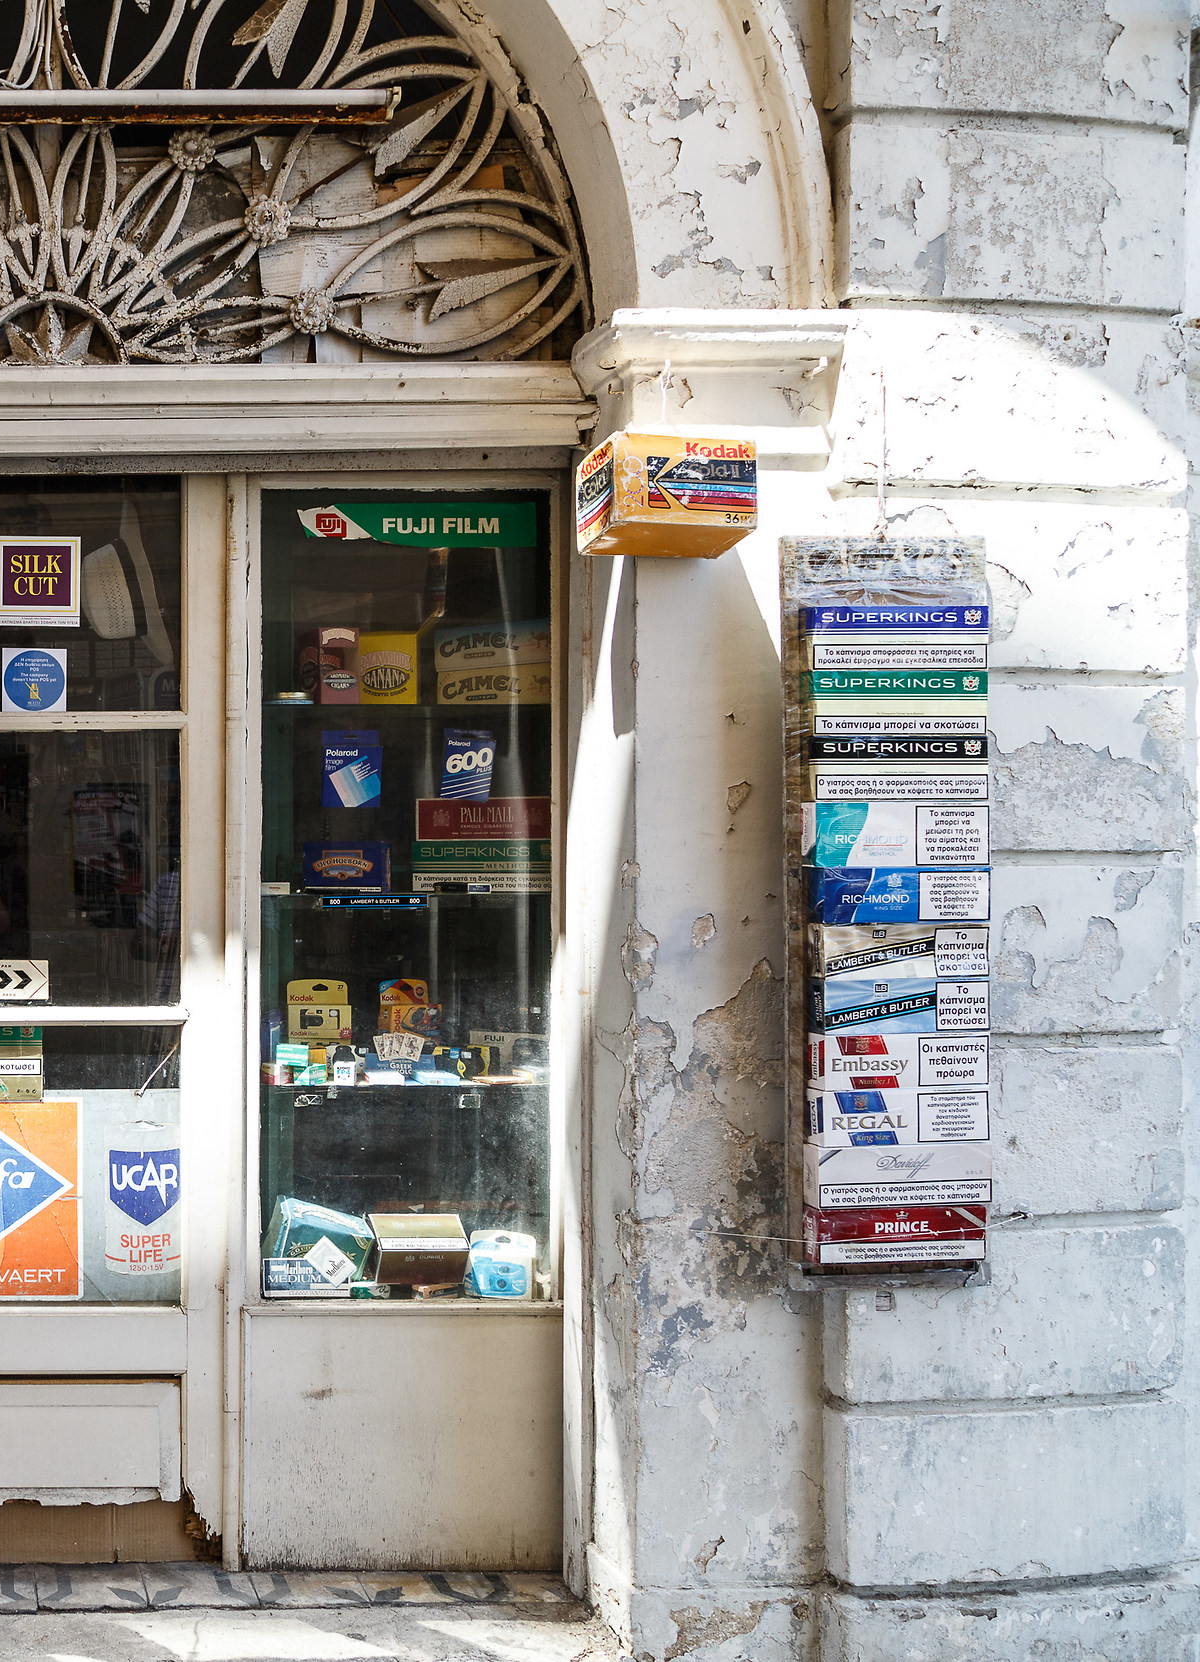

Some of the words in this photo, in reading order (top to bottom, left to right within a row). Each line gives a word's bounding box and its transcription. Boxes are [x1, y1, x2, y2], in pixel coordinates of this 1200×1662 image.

[686, 442, 750, 458] Kodak
[580, 448, 610, 479] Kodak
[725, 514, 740, 524] 36
[382, 518, 435, 534] FUJI
[442, 518, 500, 534] FILM
[10, 554, 63, 574] SILK
[13, 576, 58, 596] CUT
[821, 612, 958, 623] SUPERKINGS
[440, 632, 519, 658] CAMEL
[919, 650, 929, 658] τις
[364, 668, 406, 689] BANANA
[820, 678, 956, 689] SUPERKINGS
[442, 674, 521, 700] CAMEL
[822, 720, 833, 729] Το
[836, 719, 881, 731] κάπνισμα
[884, 720, 917, 731] μπορεί
[934, 719, 979, 729] σκοτώσει
[448, 739, 471, 747] Polaroid
[823, 743, 958, 753] SUPERKINGS
[325, 749, 359, 757] Polaroid
[325, 758, 344, 766] Image
[445, 747, 494, 775] 600
[476, 766, 493, 774] PLUS
[460, 807, 484, 823] PALL
[487, 807, 514, 822] MALL
[420, 847, 530, 857] SUPERKINGS
[317, 860, 332, 869] OLD
[333, 858, 368, 868] HOLBORN
[841, 894, 910, 904] RICHMOND
[955, 932, 968, 940] Το
[937, 941, 984, 951] κάπνισμα
[831, 954, 878, 970] LAMBERT
[886, 943, 927, 958] BUTLER
[939, 963, 986, 971] σκοτώσει
[956, 986, 969, 994] Το
[290, 994, 314, 1002] Kodak
[382, 994, 401, 1002] Kodak
[939, 995, 985, 1006] κάπνισμα
[832, 1007, 879, 1024] LAMBERT
[880, 1006, 888, 1014] &
[889, 998, 930, 1013] BUTLER
[939, 1006, 972, 1017] μπορεί
[940, 1017, 986, 1025] σκοτώσει
[922, 1044, 933, 1052] Οι
[936, 1043, 986, 1054] καπνιστές
[831, 1056, 909, 1076] Embassy
[929, 1056, 979, 1066] πεθαίνουν
[936, 1067, 975, 1079] πρόωρα
[831, 1114, 908, 1130] REGAL
[856, 1134, 874, 1143] King
[876, 1153, 934, 1179] Davidoff
[112, 1155, 179, 1207] UCAR
[874, 1220, 929, 1234] PRINCE
[120, 1234, 171, 1249] SUPER
[129, 1250, 163, 1263] LIFE
[268, 1274, 322, 1283] MEDIUM
